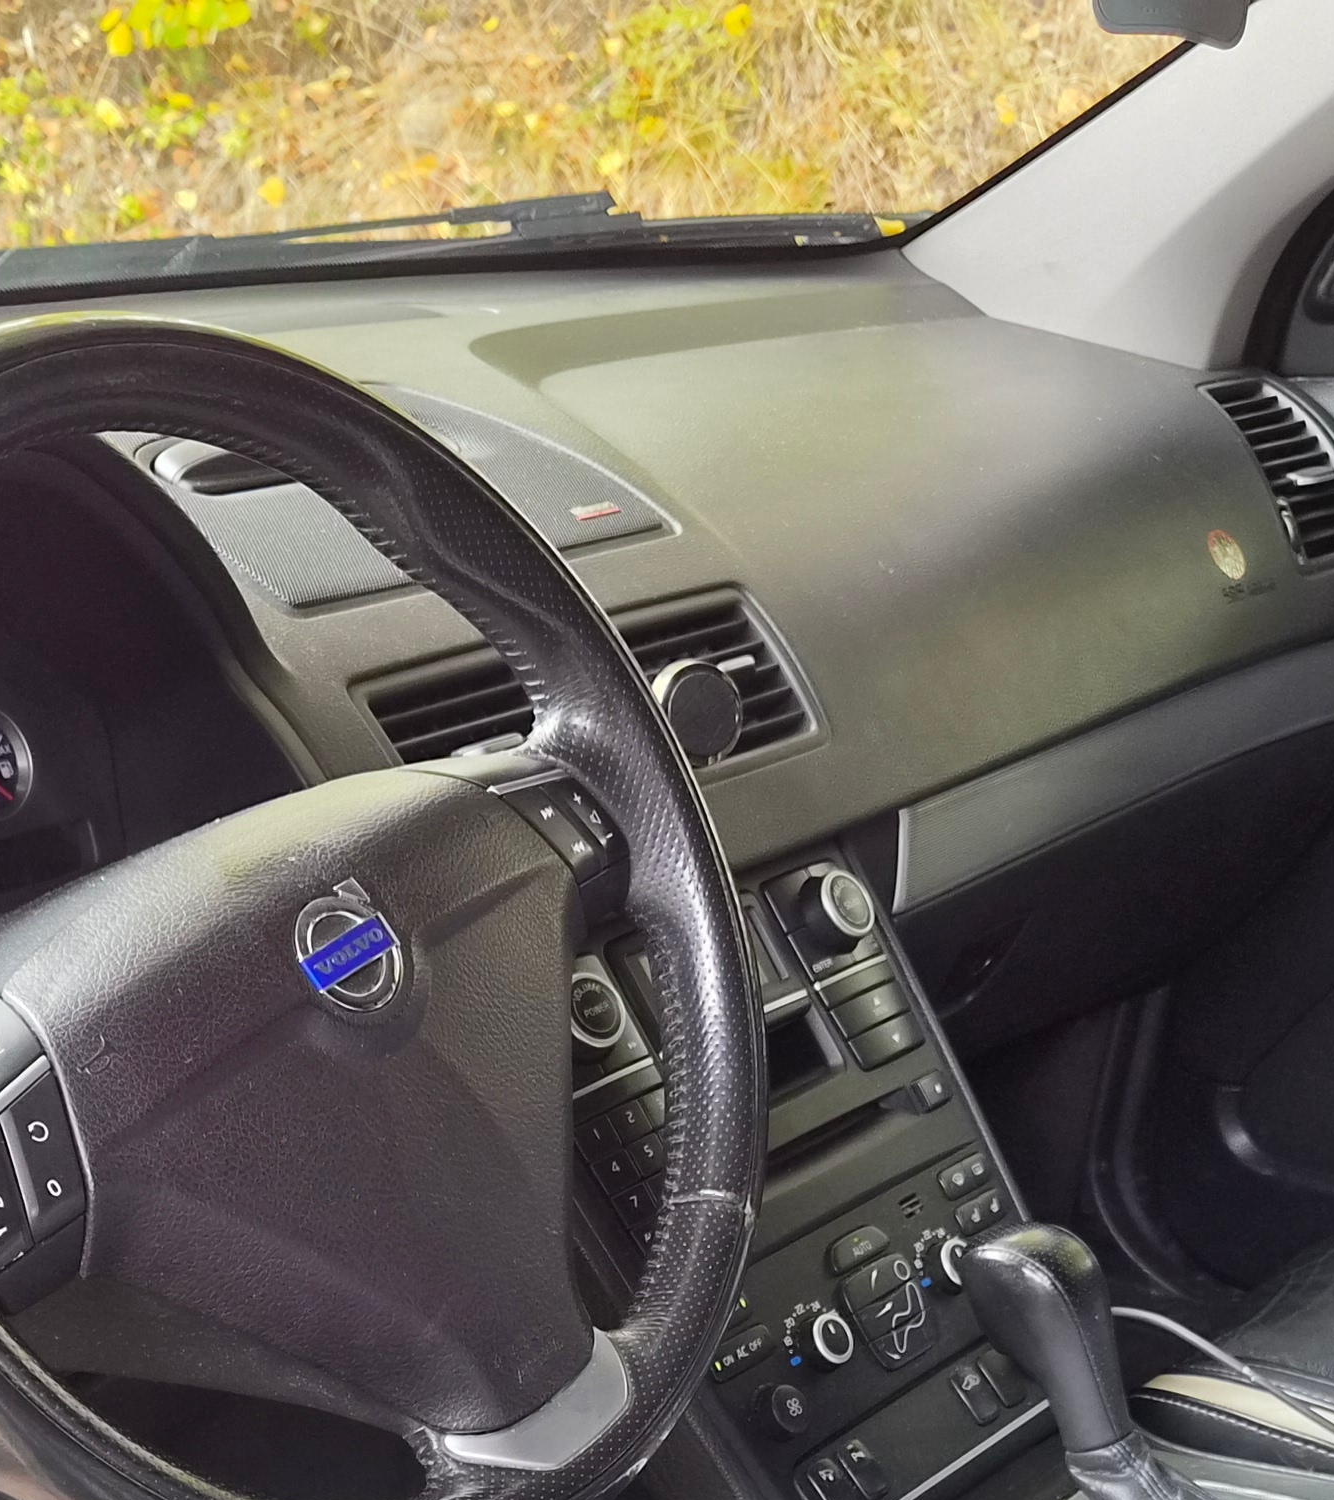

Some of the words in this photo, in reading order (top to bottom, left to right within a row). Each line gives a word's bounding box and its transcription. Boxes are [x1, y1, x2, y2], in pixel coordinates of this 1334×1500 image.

[313, 927, 384, 975] VOLVO
[584, 1001, 610, 1018] POWER
[625, 1111, 636, 1124] 2
[593, 1128, 601, 1140] 1
[643, 1144, 654, 1157] 5
[611, 1161, 620, 1172] 4
[629, 1195, 638, 1208] 7
[852, 1240, 873, 1257] AUTO
[794, 1303, 805, 1315] 22
[722, 1355, 735, 1367] ON
[736, 1345, 749, 1360] AC
[749, 1338, 763, 1352] OFF
